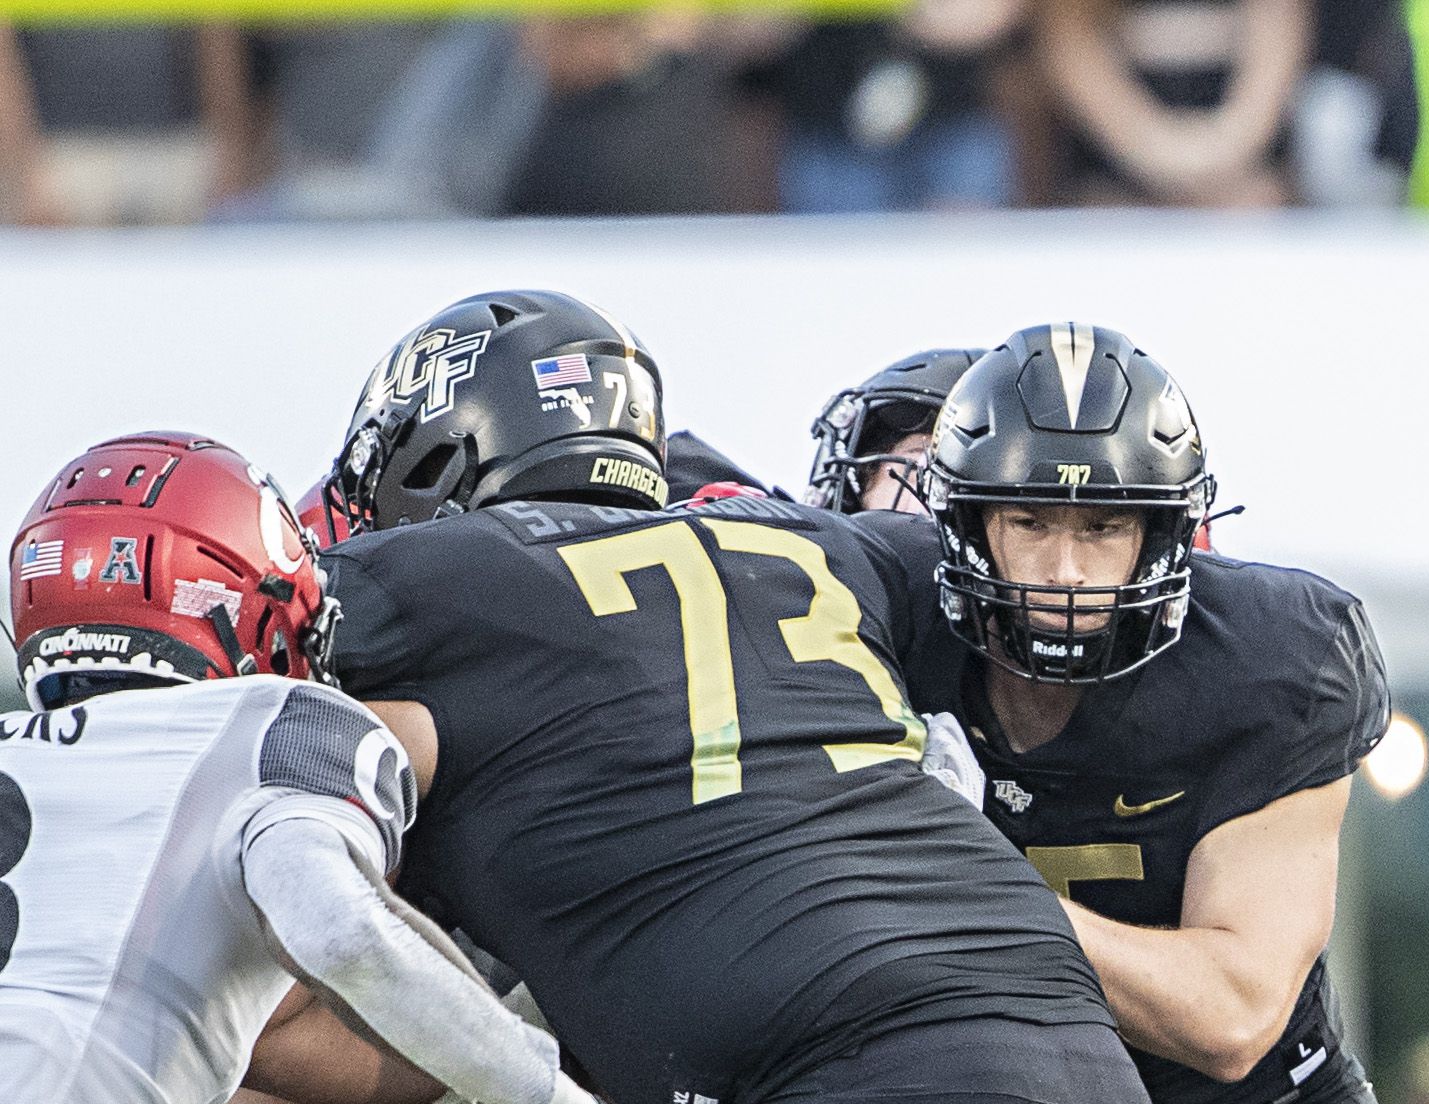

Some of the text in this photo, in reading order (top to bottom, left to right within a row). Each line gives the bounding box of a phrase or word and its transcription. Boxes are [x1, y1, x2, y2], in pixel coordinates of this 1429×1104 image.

[39, 627, 132, 657] CINCINNATI
[1032, 640, 1084, 657] Riddll
[556, 517, 929, 805] 73
[992, 779, 1033, 813] UCF
